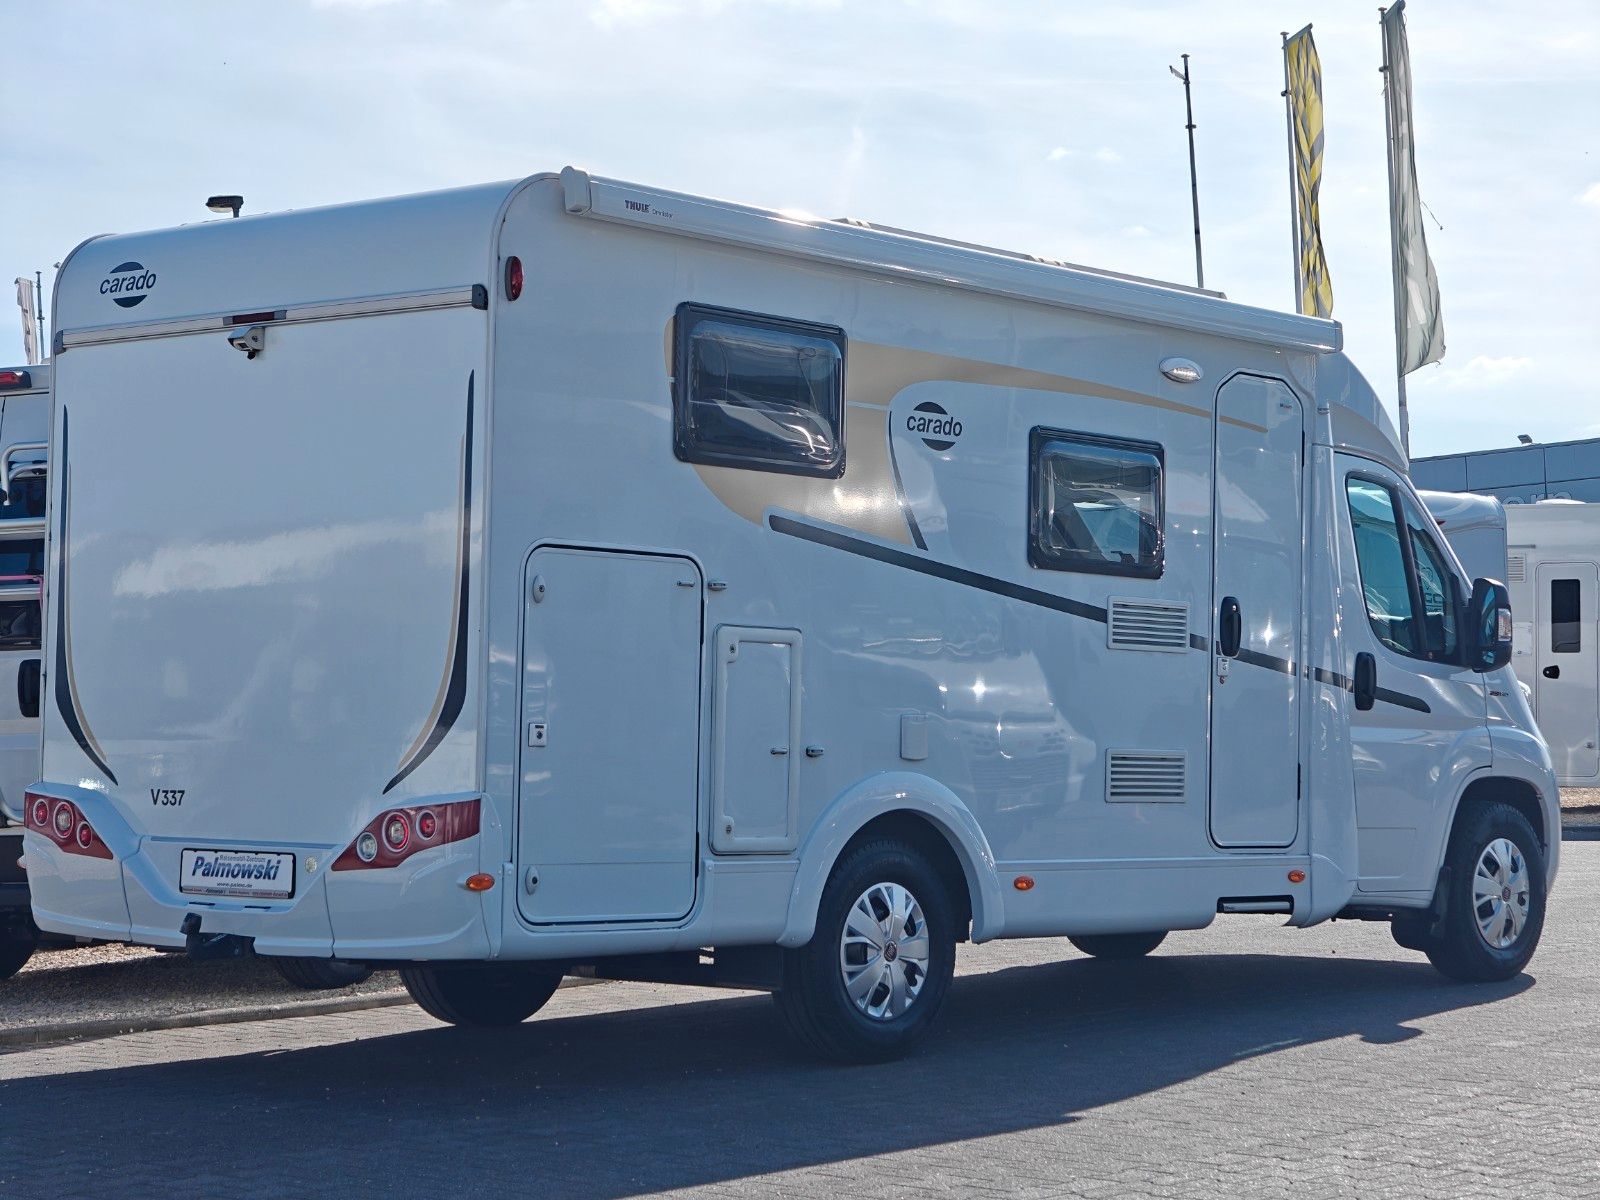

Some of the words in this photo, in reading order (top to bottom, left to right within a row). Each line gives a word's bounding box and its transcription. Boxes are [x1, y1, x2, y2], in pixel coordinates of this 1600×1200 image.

[625, 199, 650, 212] THULE
[100, 270, 157, 294] carado
[907, 416, 963, 437] carado
[192, 856, 281, 880] Palmowski
